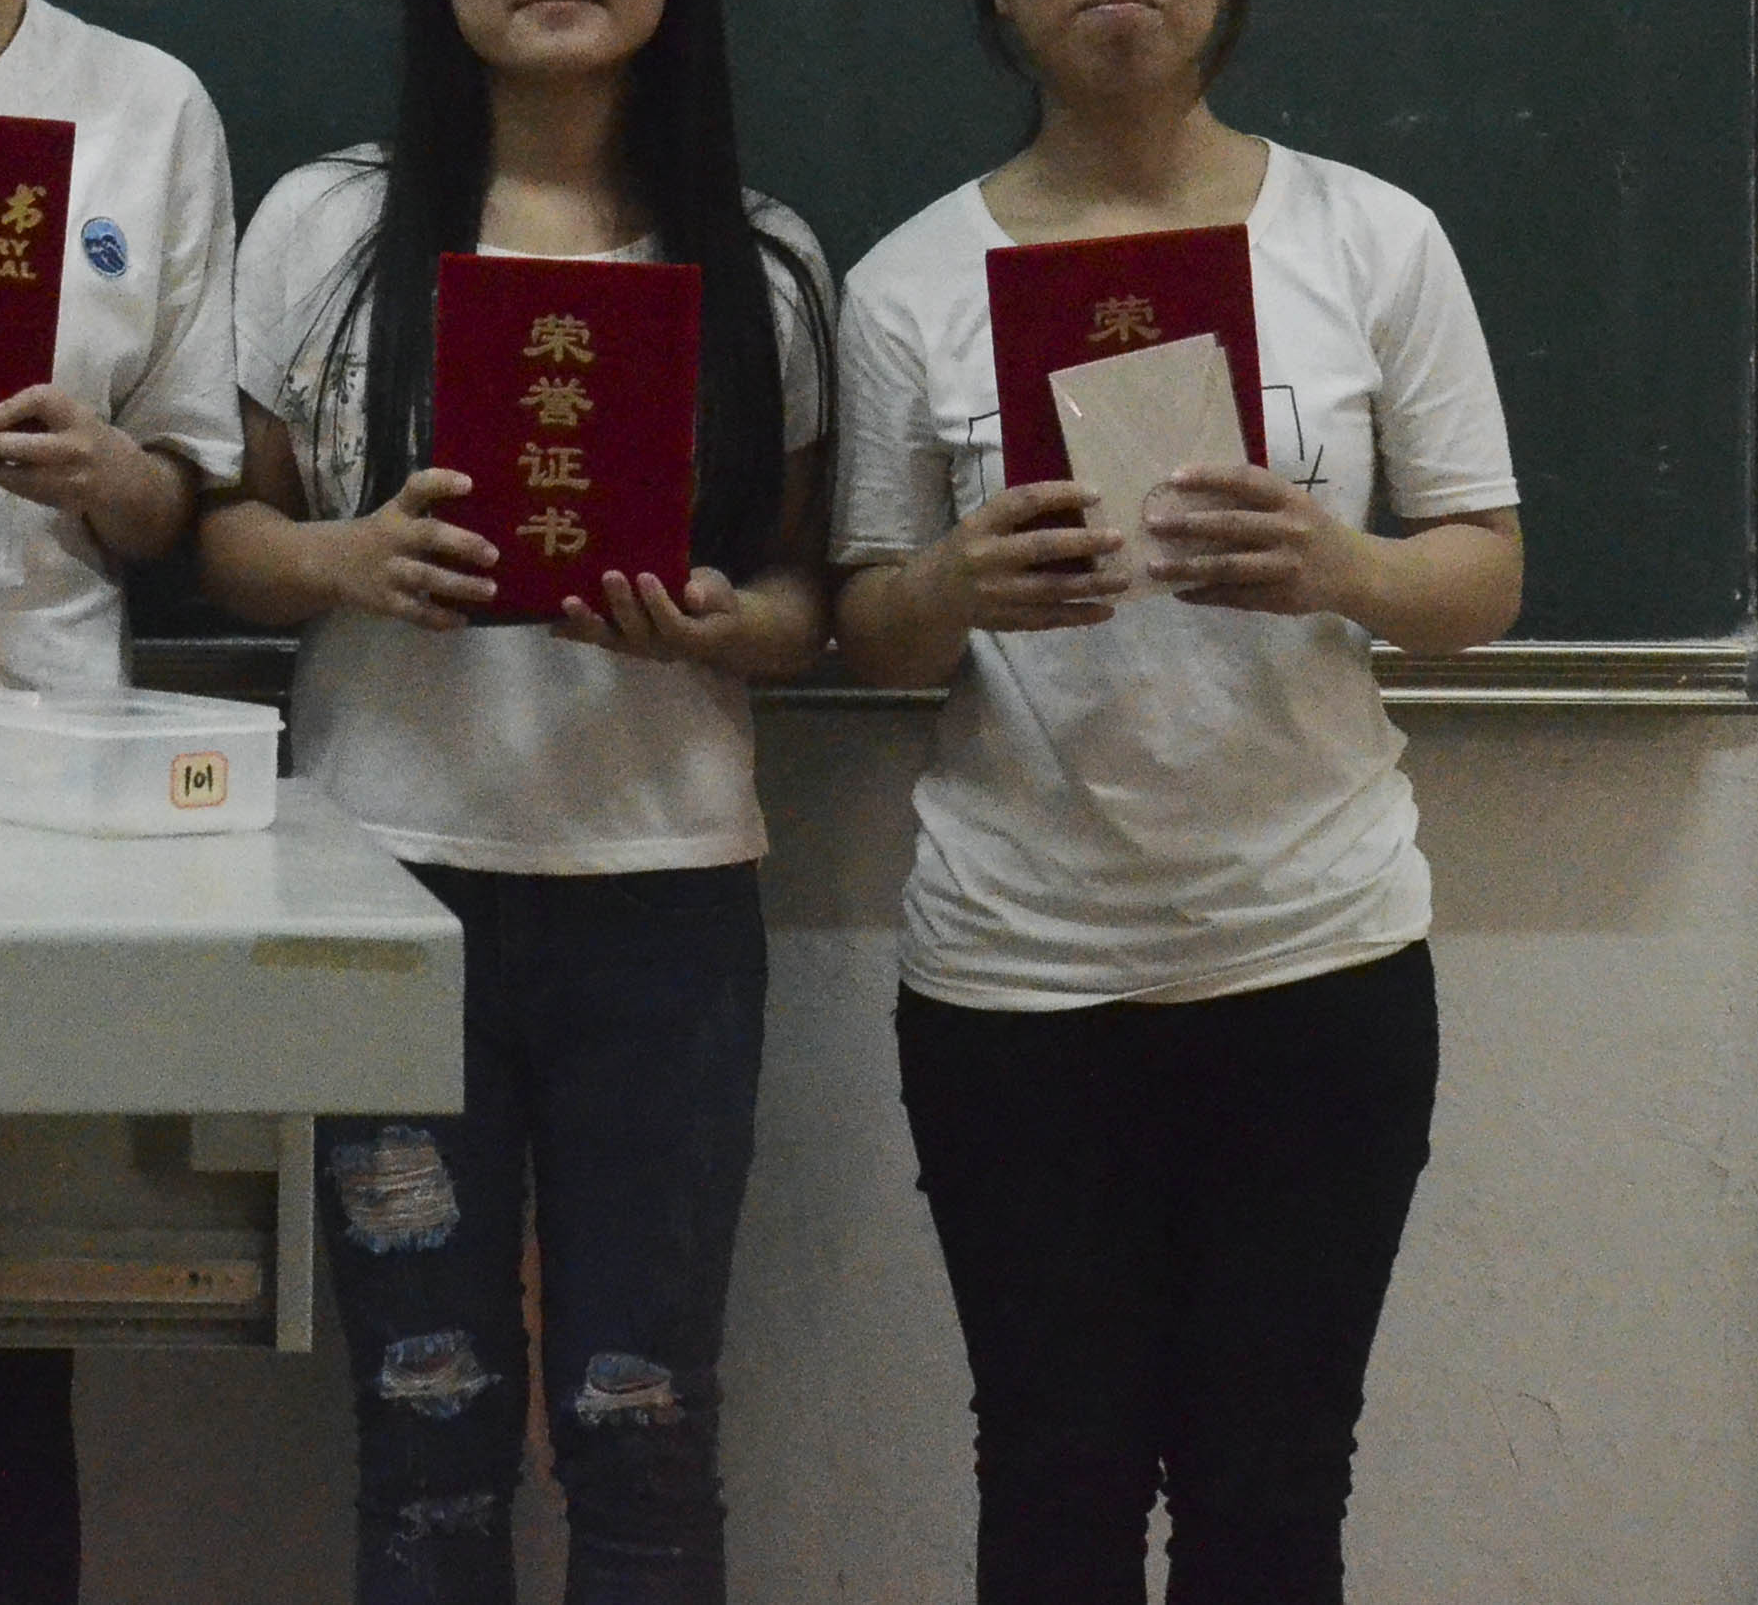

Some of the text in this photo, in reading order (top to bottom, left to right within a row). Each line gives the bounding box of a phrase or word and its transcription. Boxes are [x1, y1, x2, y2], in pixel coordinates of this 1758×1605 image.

[1087, 295, 1161, 343] 荣
[515, 313, 595, 557] 荣誉证书
